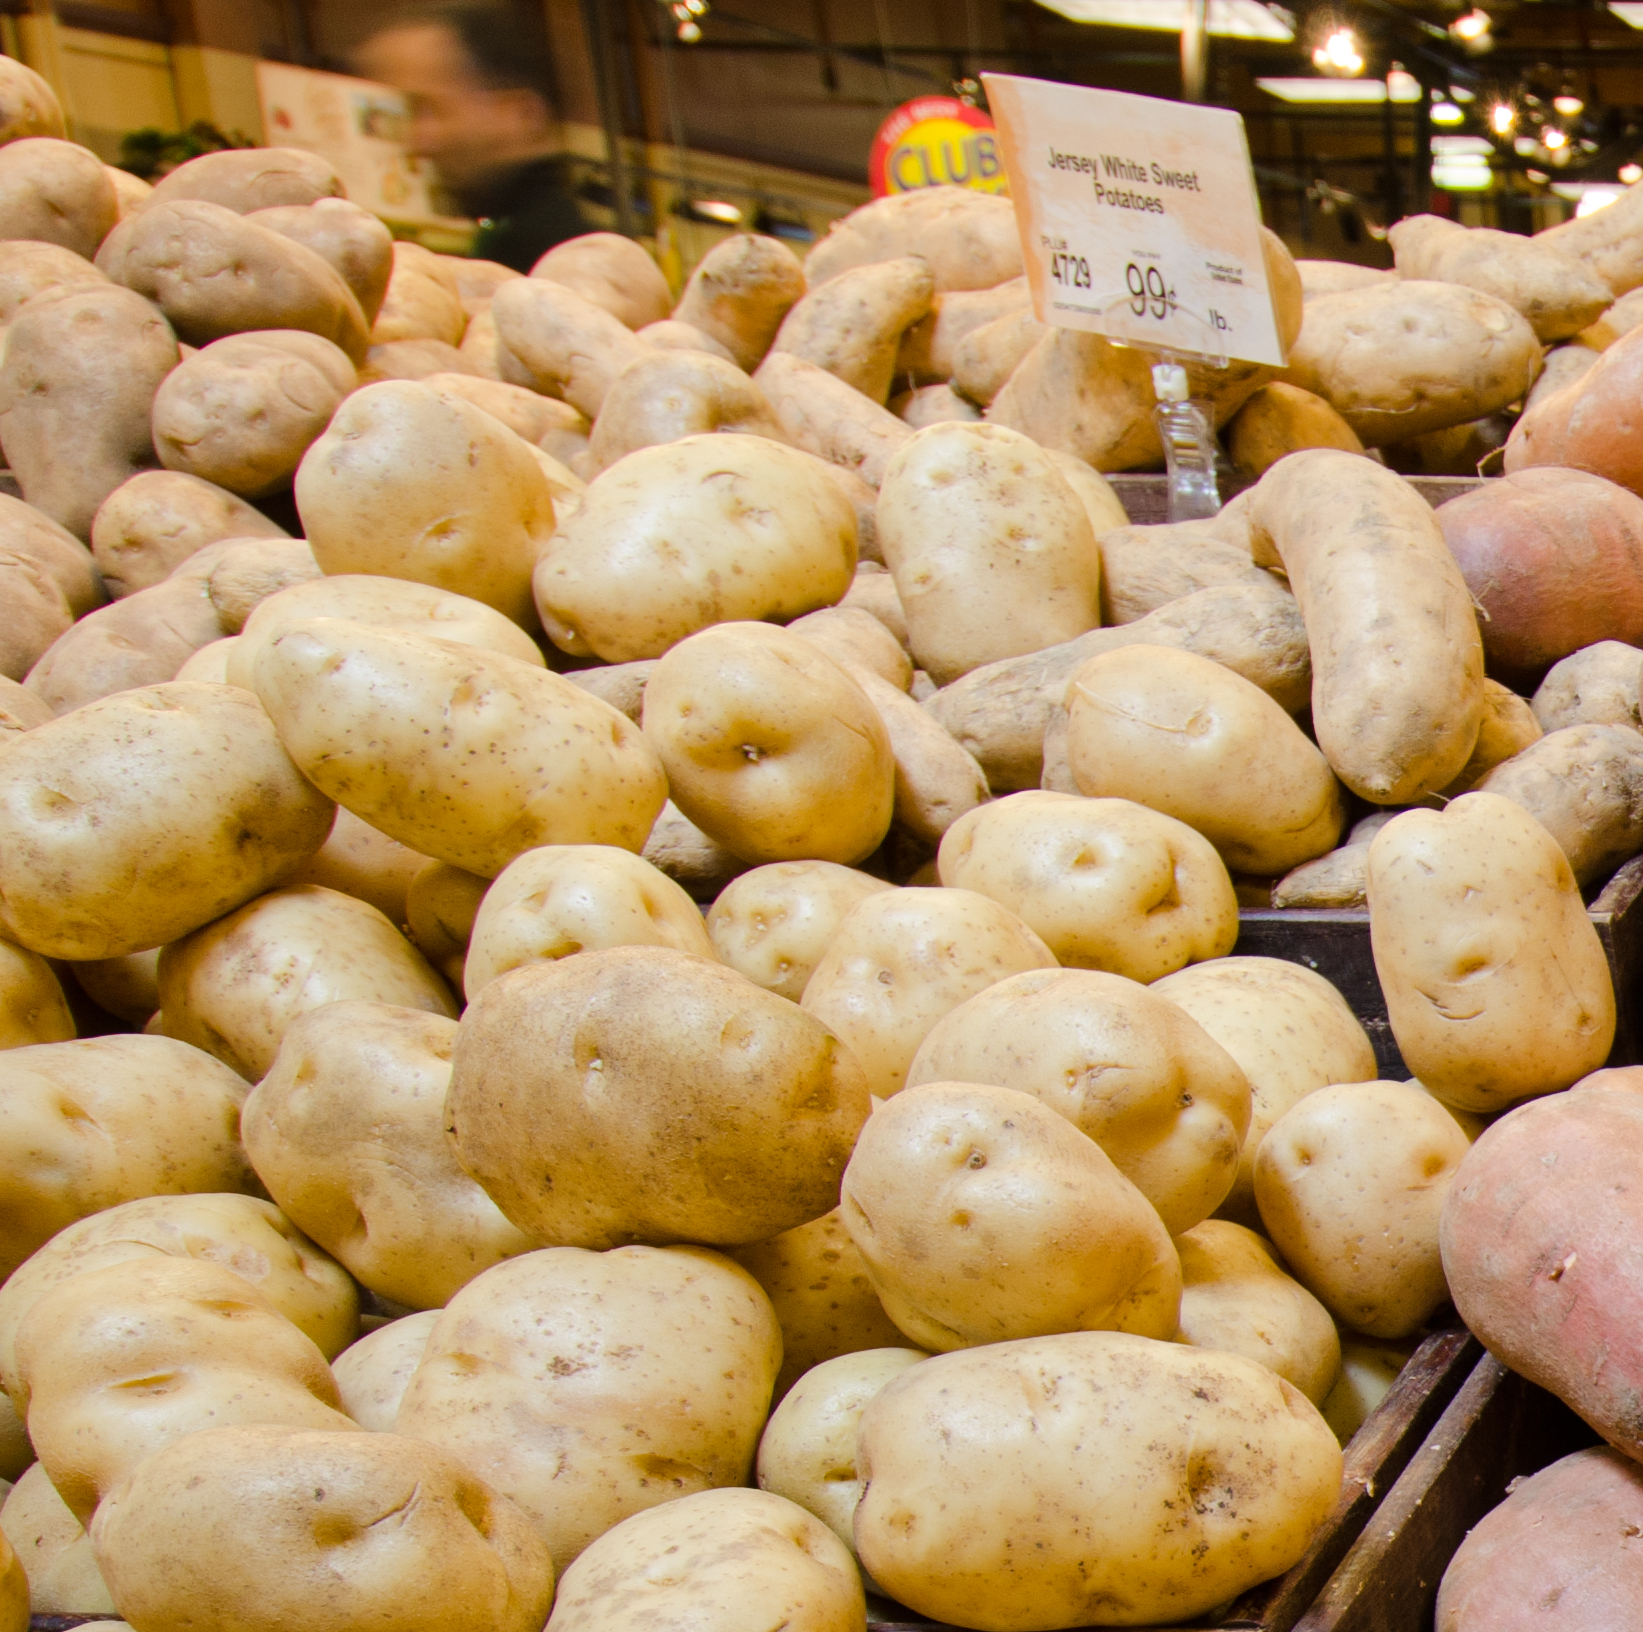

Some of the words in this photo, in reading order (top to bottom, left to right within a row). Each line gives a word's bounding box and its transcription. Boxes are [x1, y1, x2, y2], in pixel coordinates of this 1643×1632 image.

[891, 135, 1000, 190] CLUB
[1048, 147, 1098, 180] Jersey
[1100, 153, 1148, 183] White
[1150, 162, 1201, 192] Sweet
[1094, 182, 1164, 214] Potatoes
[1051, 252, 1092, 289] 4729
[1208, 309, 1232, 331] lb.
